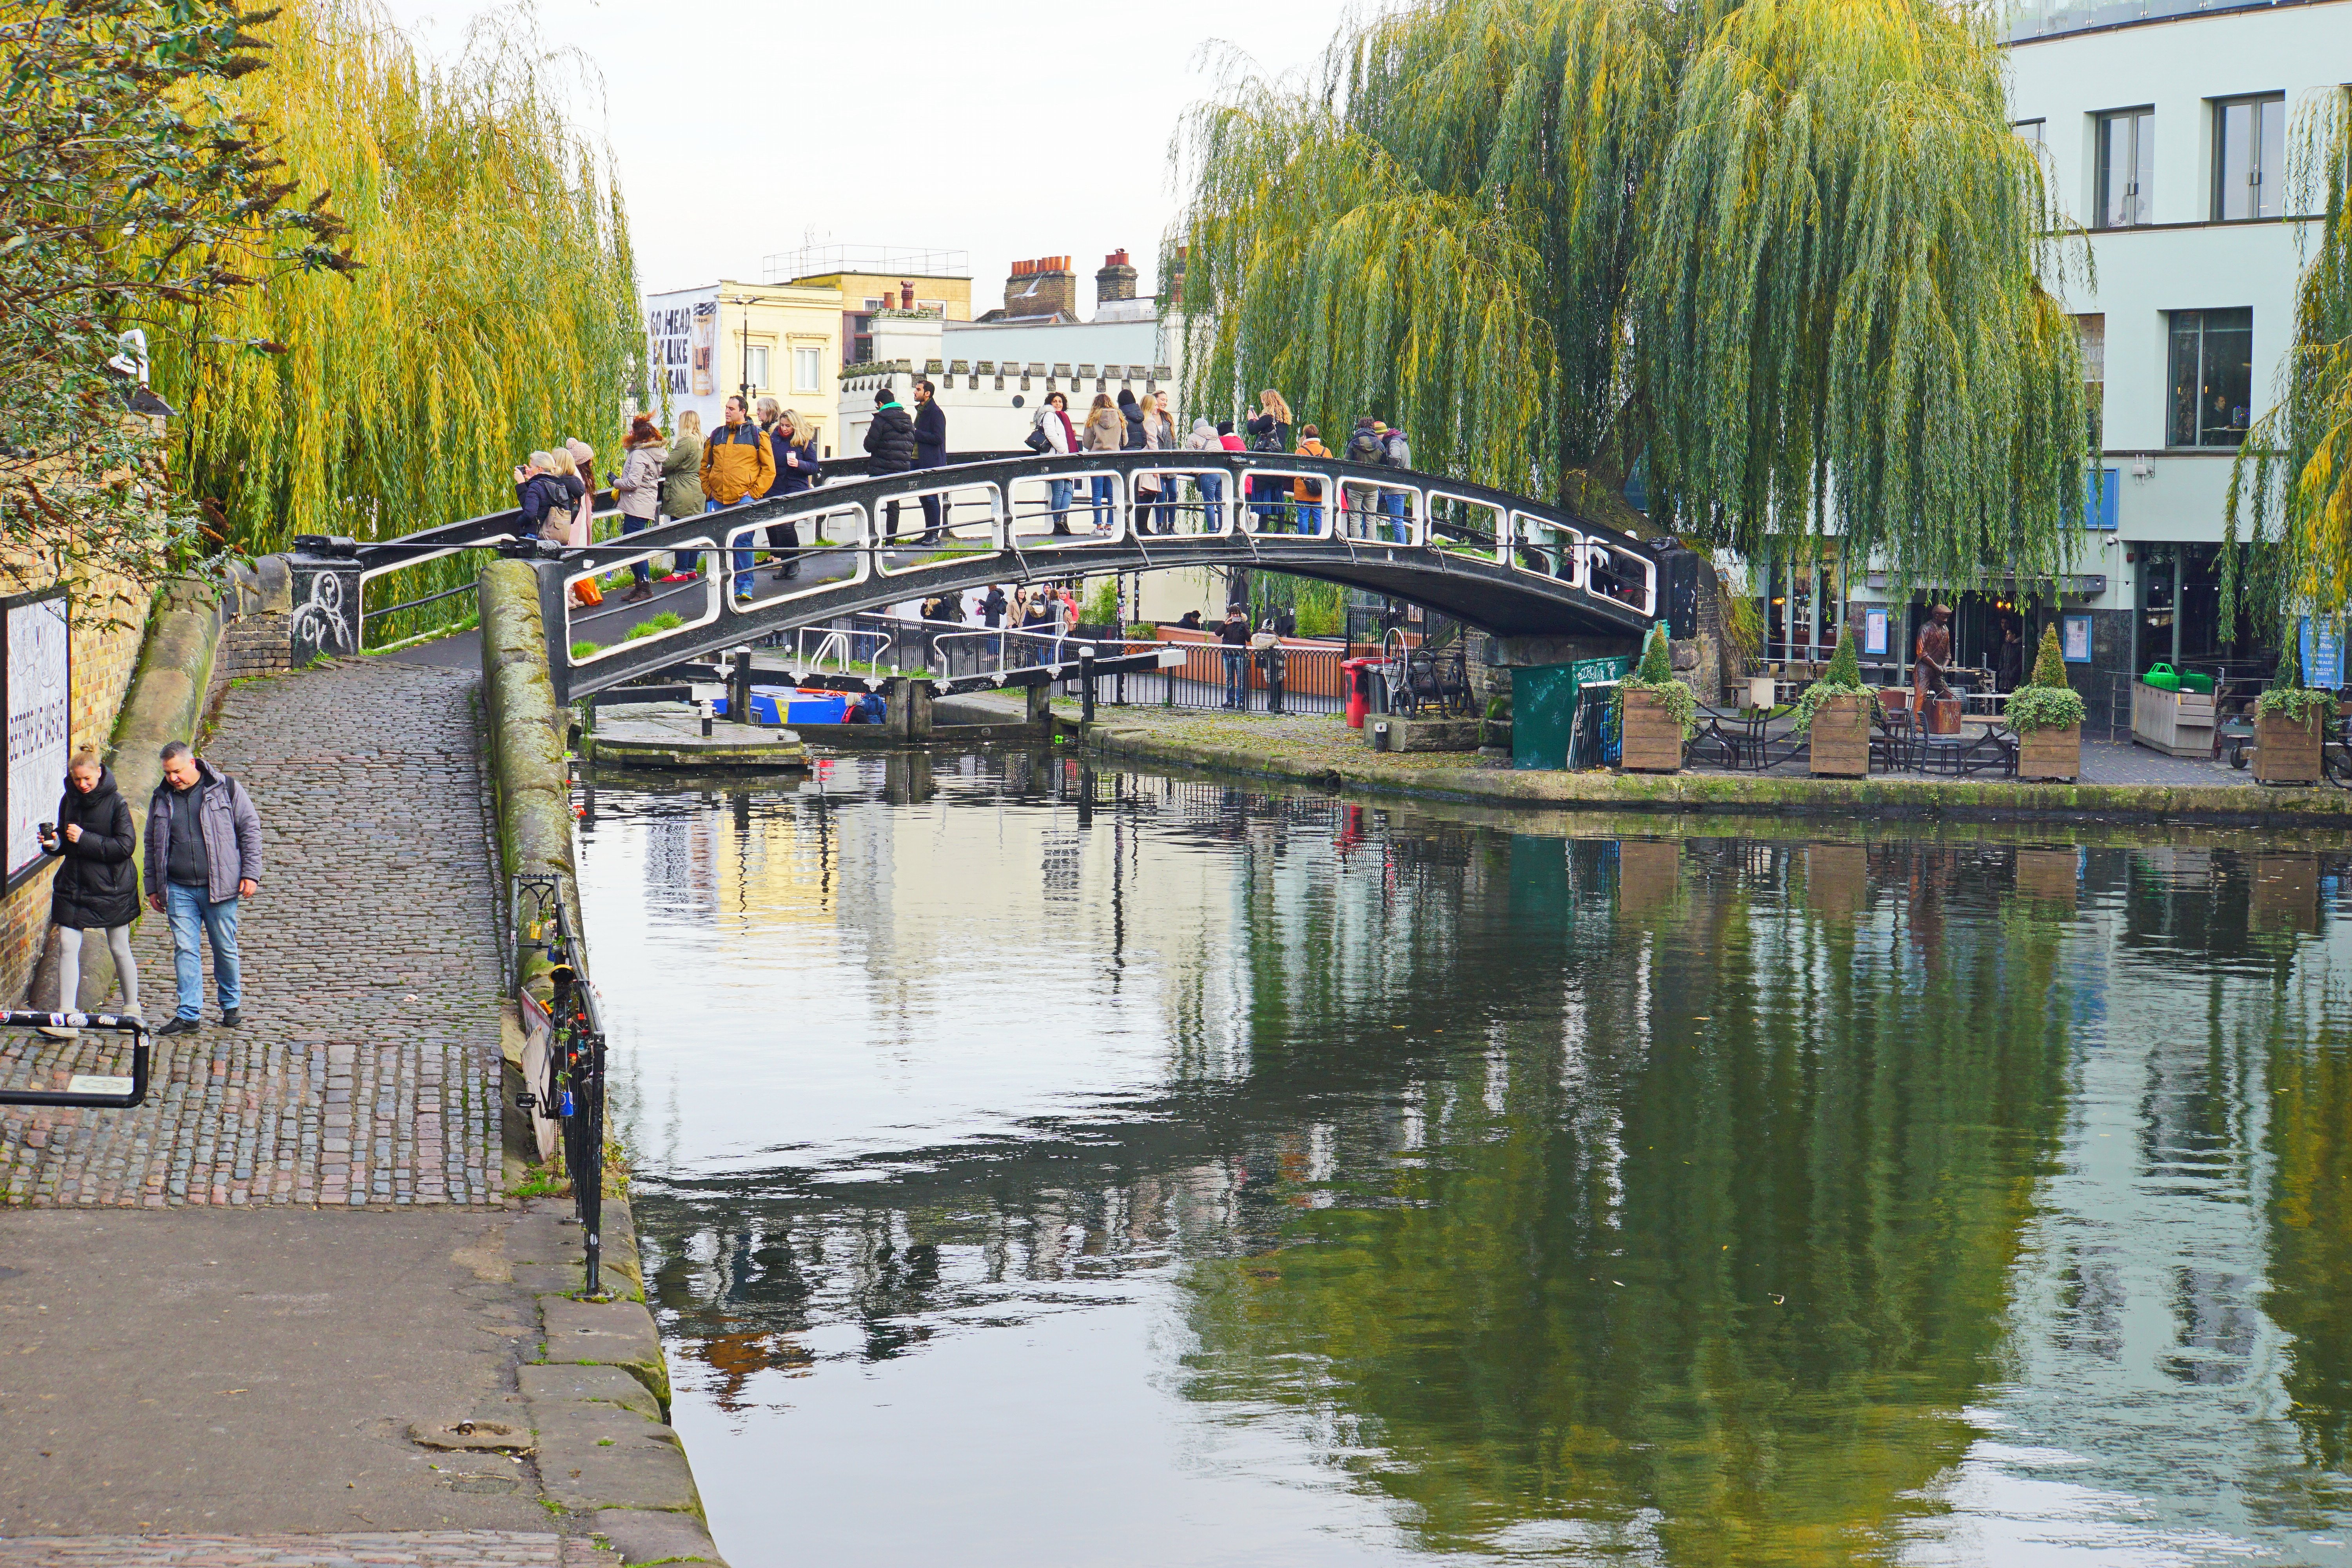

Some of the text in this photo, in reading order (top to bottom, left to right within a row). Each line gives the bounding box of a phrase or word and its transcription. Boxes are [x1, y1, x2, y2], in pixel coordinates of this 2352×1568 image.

[651, 310, 661, 336] GO
[667, 338, 688, 365] LIKE
[10, 710, 34, 762] BEFORE
